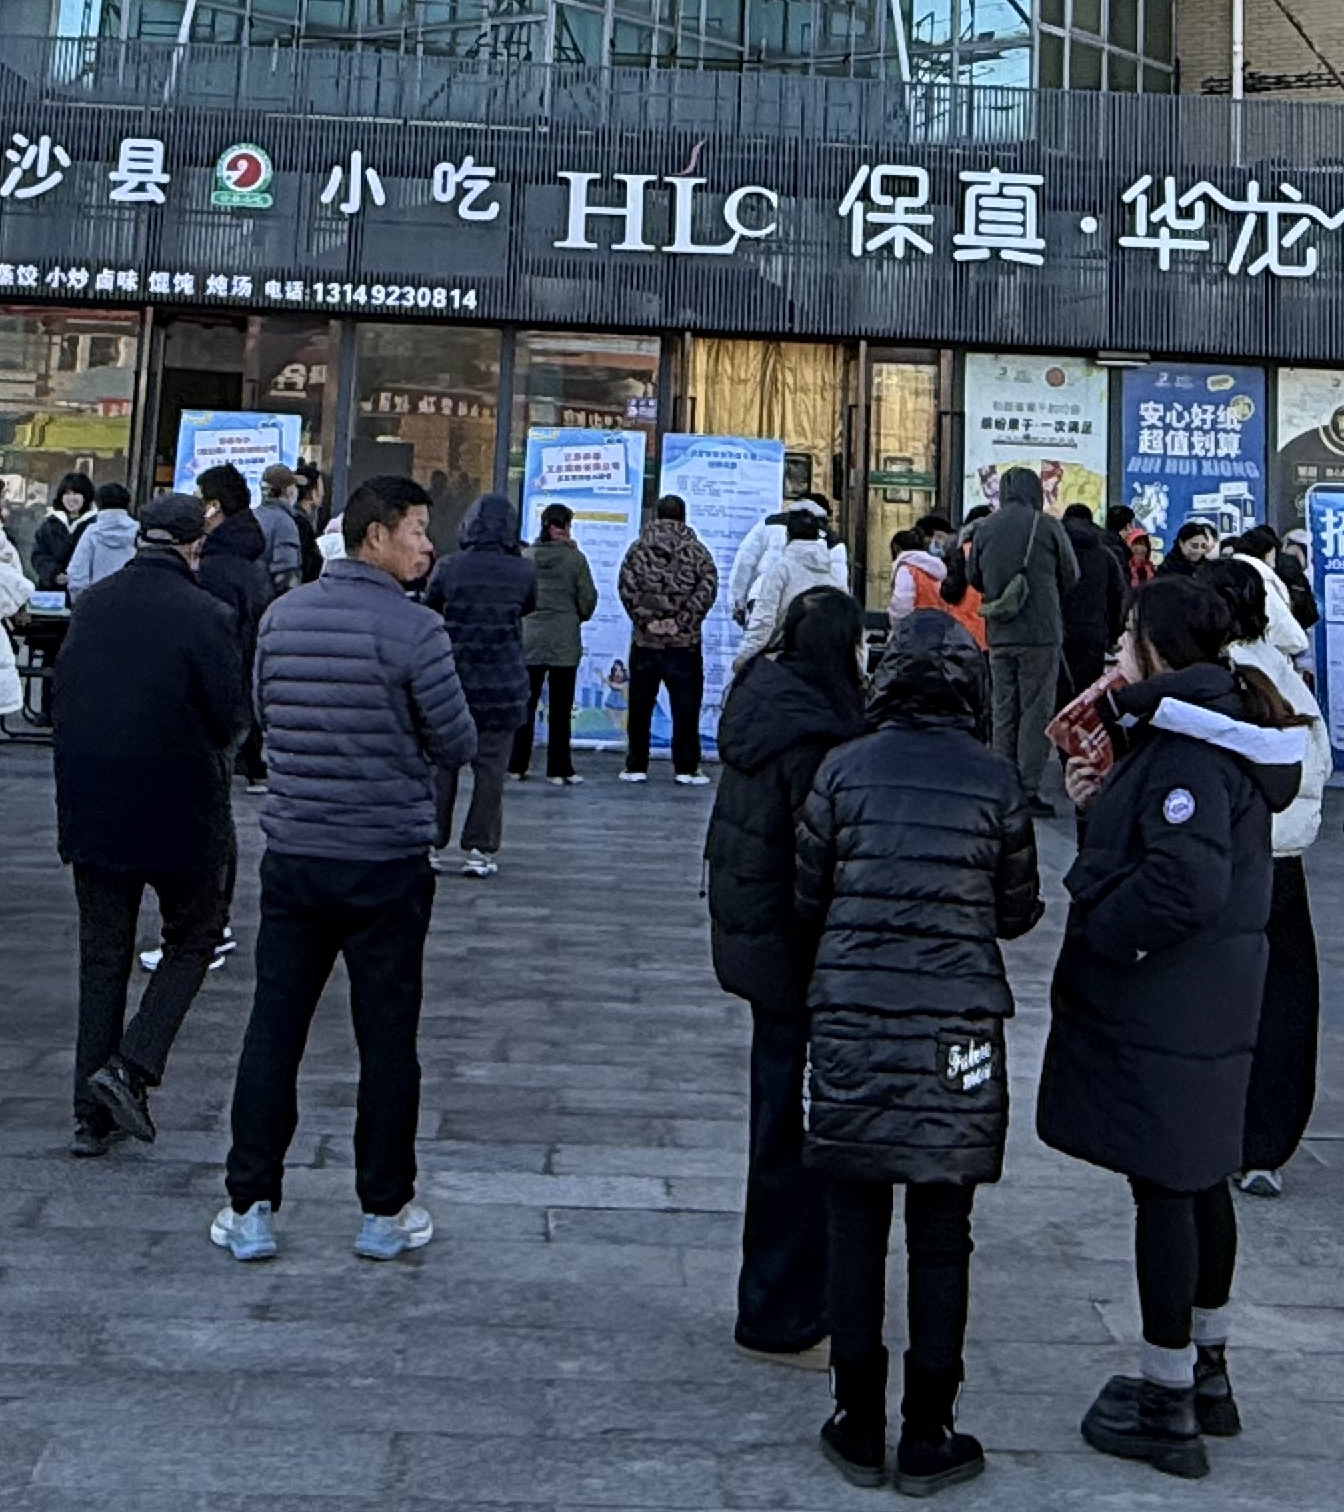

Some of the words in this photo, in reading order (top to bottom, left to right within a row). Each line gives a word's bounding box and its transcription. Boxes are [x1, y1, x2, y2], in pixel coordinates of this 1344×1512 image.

[0, 132, 171, 204] 沙县
[320, 150, 500, 221] 小吃
[45, 266, 90, 291] 小炒
[94, 267, 139, 292] 卤味
[1138, 429, 1242, 459] 超值划算
